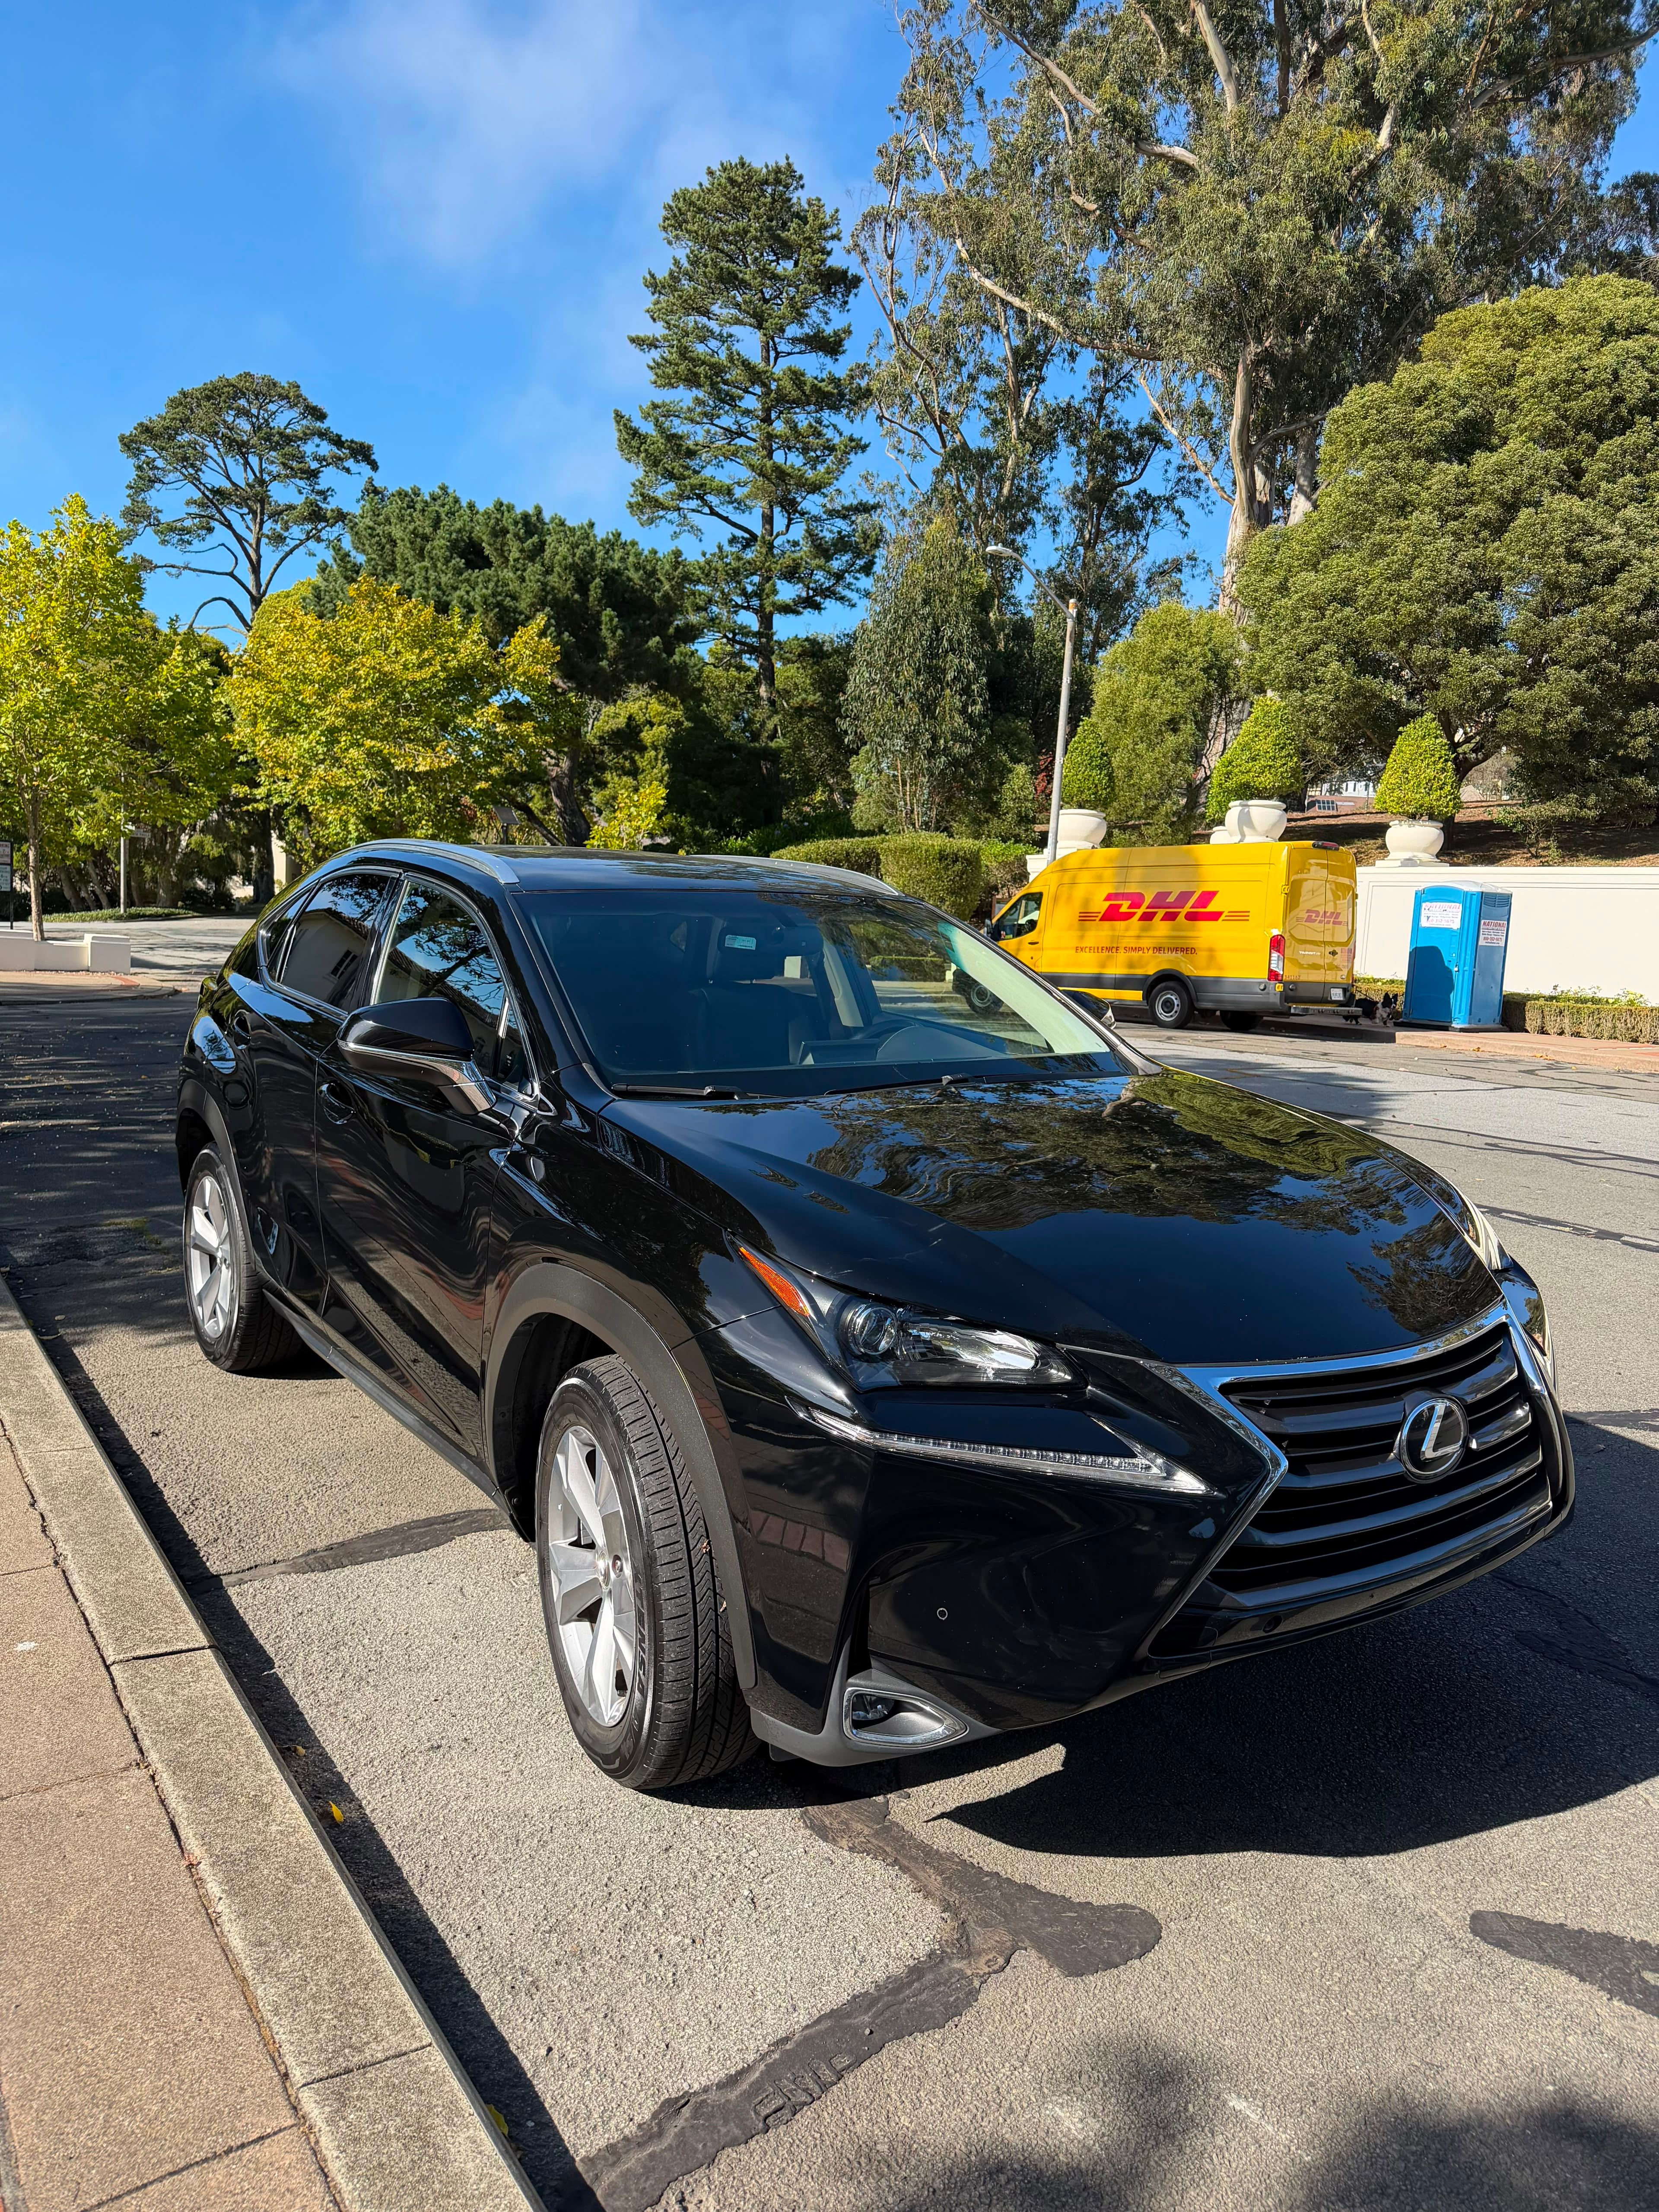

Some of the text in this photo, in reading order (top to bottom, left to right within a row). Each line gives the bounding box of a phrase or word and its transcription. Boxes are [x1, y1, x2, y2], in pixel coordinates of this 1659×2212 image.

[1099, 891, 1224, 921] DHL
[1304, 909, 1343, 925] DHL
[1123, 946, 1151, 954] SIMPLY
[1153, 947, 1198, 955] DELIVERED.
